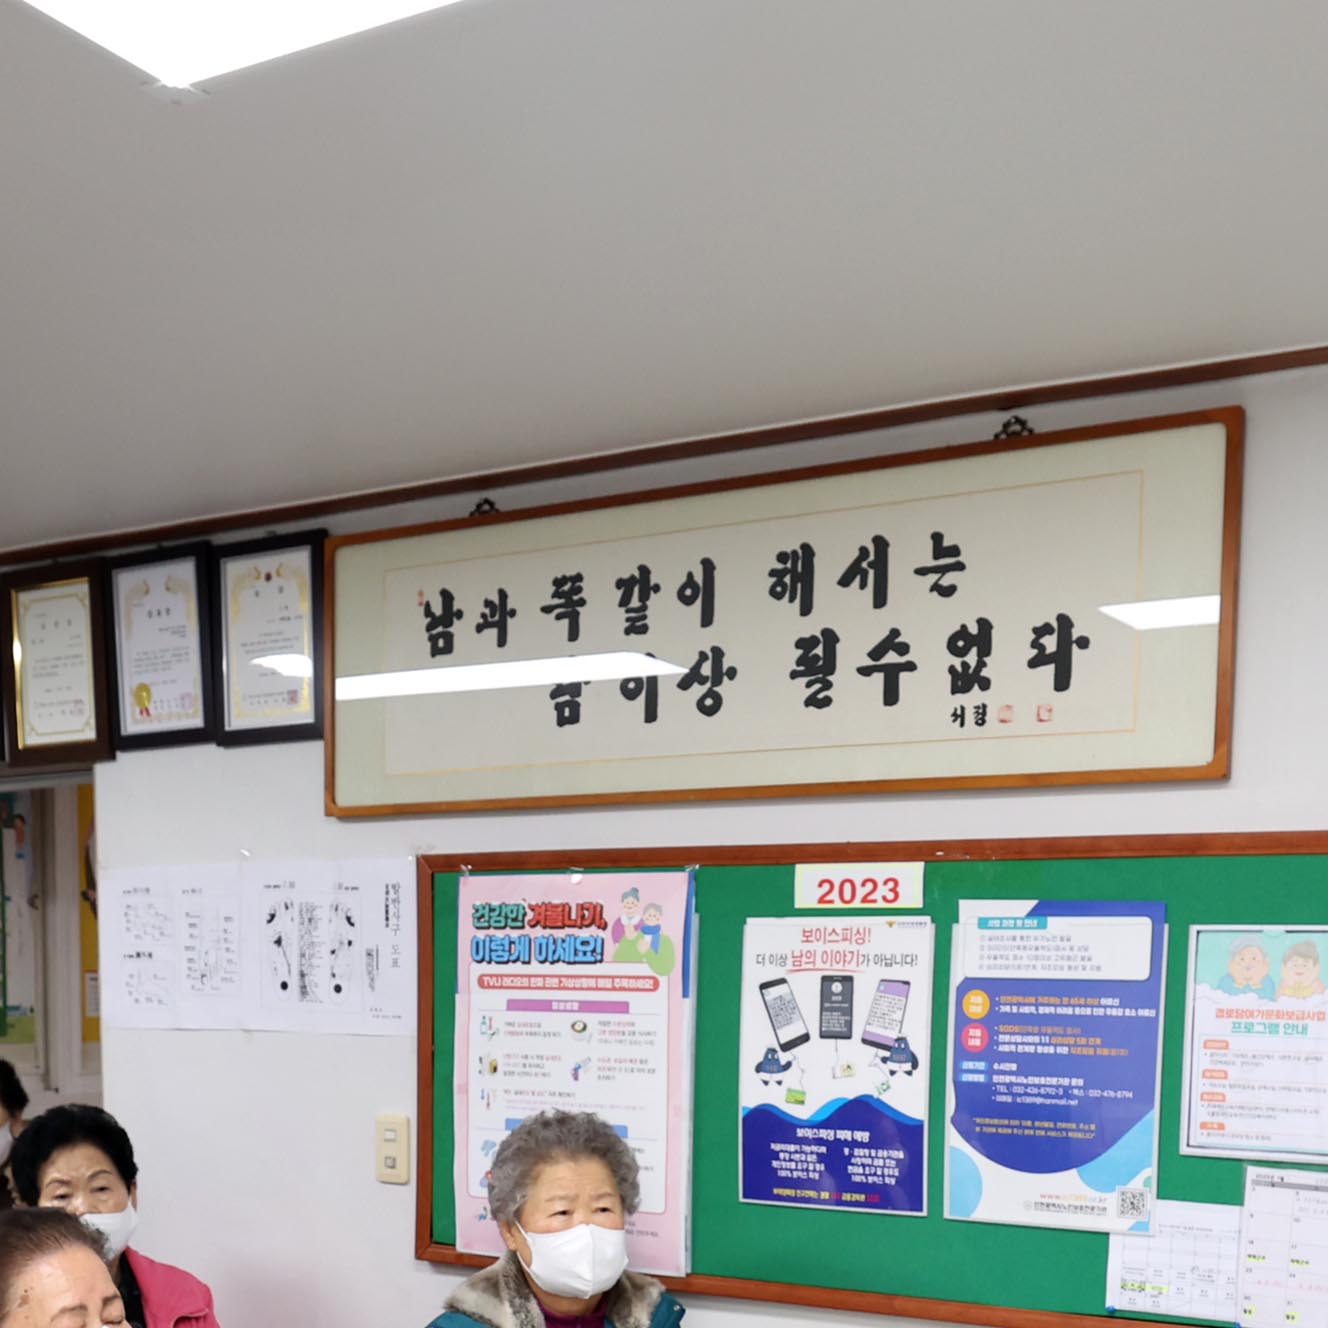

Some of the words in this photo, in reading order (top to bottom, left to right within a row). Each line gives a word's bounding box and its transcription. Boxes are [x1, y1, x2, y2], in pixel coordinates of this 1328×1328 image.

[768, 531, 967, 617] 해서는
[817, 877, 900, 904] 2023
[472, 903, 526, 929] 건강한
[528, 902, 608, 930] 겨울나기,
[471, 934, 531, 964] 이렇게
[534, 935, 604, 964] 하세요!
[801, 927, 871, 945] 보이스피싱!
[756, 953, 765, 966] 더
[769, 953, 788, 966] 이상
[791, 950, 817, 968] 남의
[821, 950, 870, 968] 이야기가
[873, 953, 918, 967] 아닙니다!
[1231, 1021, 1280, 1035] 프로그램
[1283, 1023, 1308, 1035] 안내
